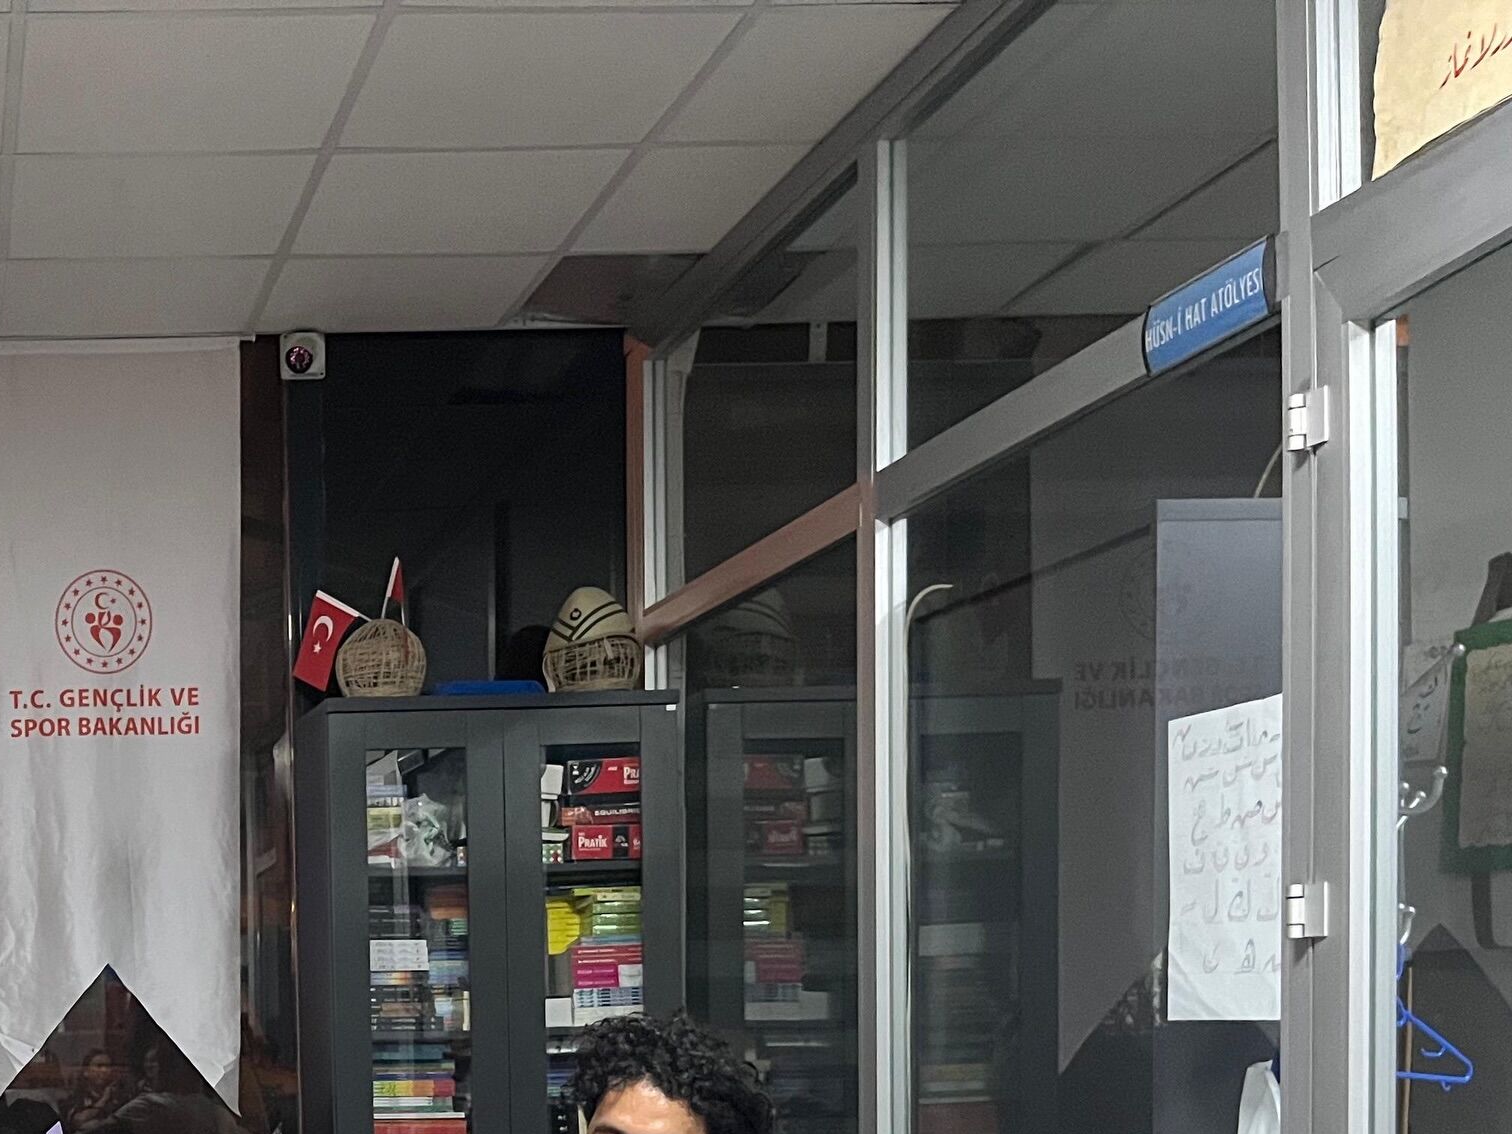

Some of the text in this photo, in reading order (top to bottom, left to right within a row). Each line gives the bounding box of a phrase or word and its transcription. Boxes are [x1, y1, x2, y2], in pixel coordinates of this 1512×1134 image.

[1185, 297, 1207, 331] HAT
[9, 684, 200, 712] T.C. GENÇLİK VE
[10, 712, 200, 738] SPOR BAKANLIĞI
